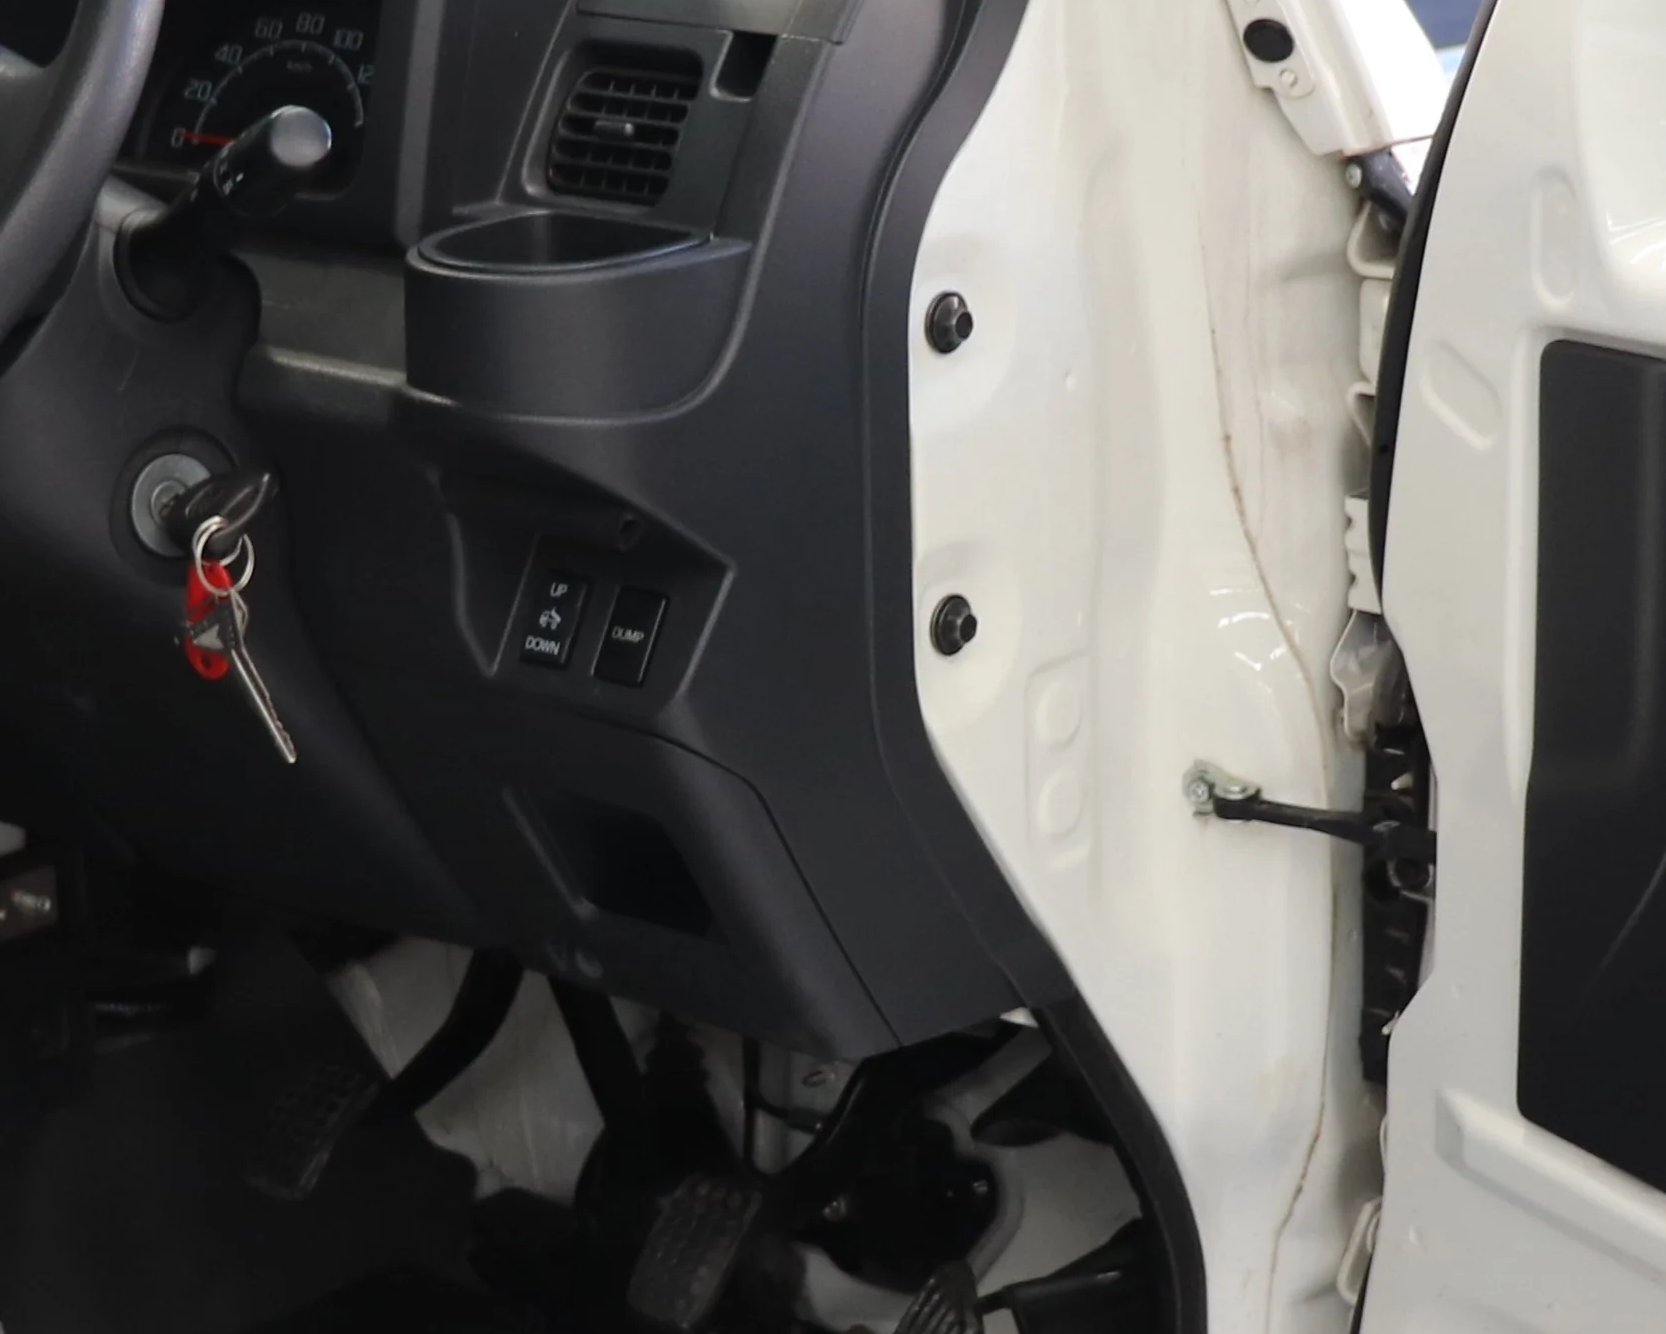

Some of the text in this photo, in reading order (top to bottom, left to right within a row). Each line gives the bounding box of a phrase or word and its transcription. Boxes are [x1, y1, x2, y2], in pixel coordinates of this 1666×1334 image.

[254, 16, 283, 40] 60
[295, 12, 325, 36] 80
[333, 28, 364, 51] 100
[214, 43, 243, 65] 40
[183, 77, 213, 101] 20
[550, 582, 568, 597] UP
[525, 635, 561, 655] DOWN
[612, 626, 644, 643] DUMP
